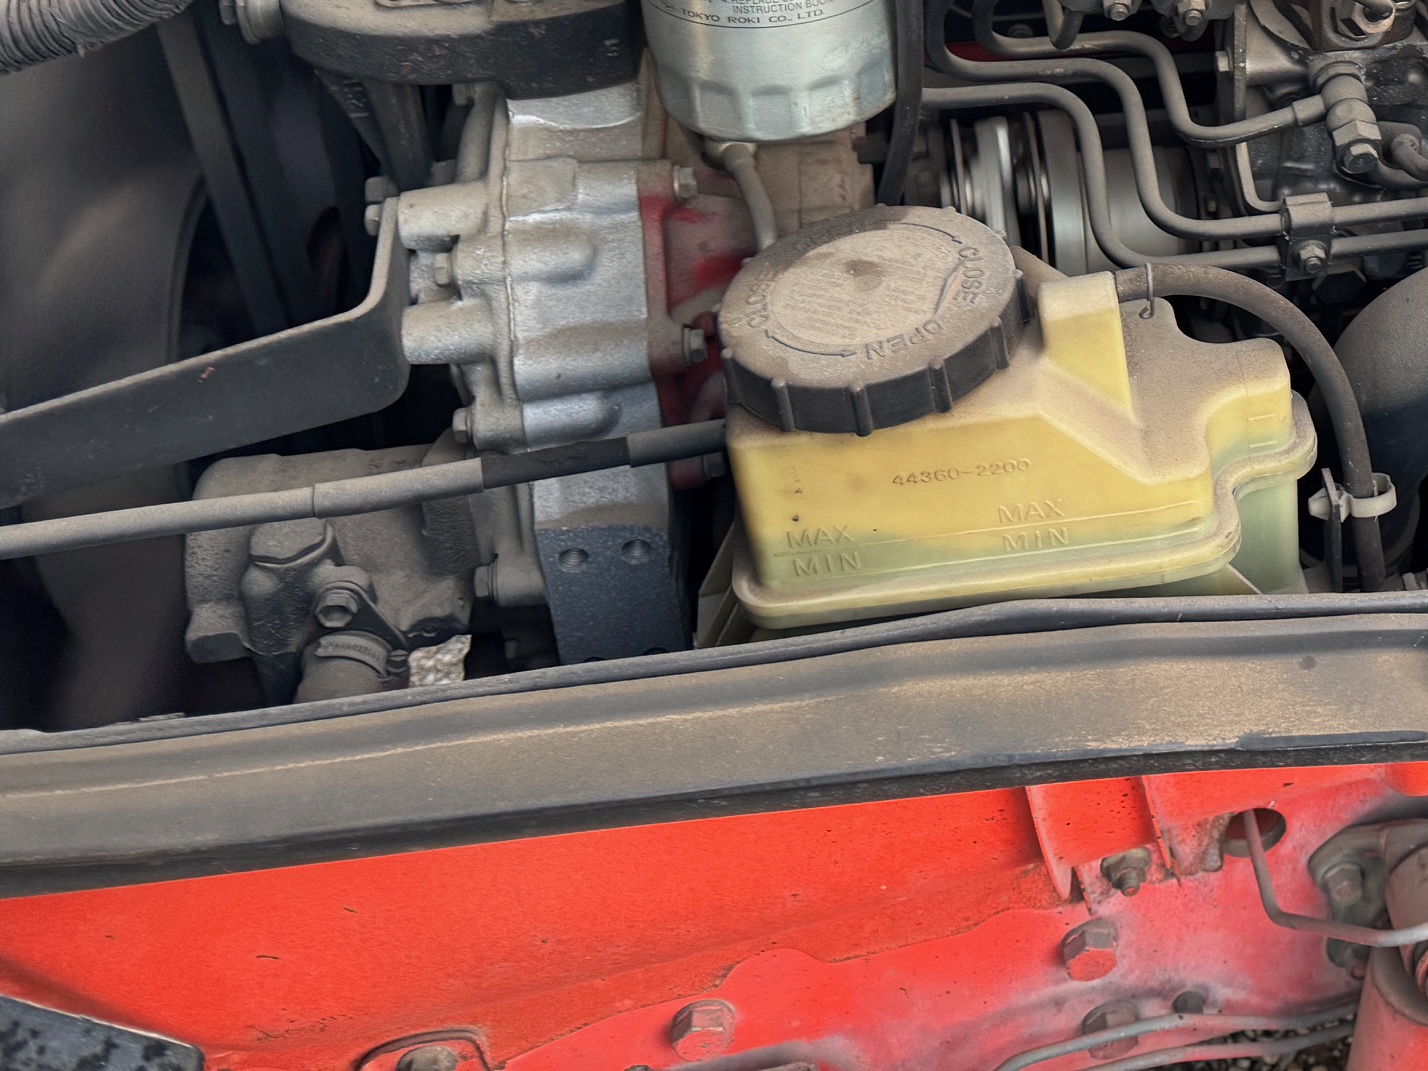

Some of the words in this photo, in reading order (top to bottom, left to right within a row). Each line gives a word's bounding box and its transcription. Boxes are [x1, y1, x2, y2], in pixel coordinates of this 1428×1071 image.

[680, 7, 721, 22] TOKYO
[727, 16, 760, 24] ROKI
[732, 1, 803, 14] INSTRUCTION
[957, 245, 984, 305] CLOSE
[864, 318, 943, 360] OPEN
[891, 457, 1033, 486] 44360-2200
[997, 498, 1065, 524] MAX
[785, 524, 856, 549] MAX
[1002, 526, 1070, 552] MIN
[791, 550, 862, 577] MIN
